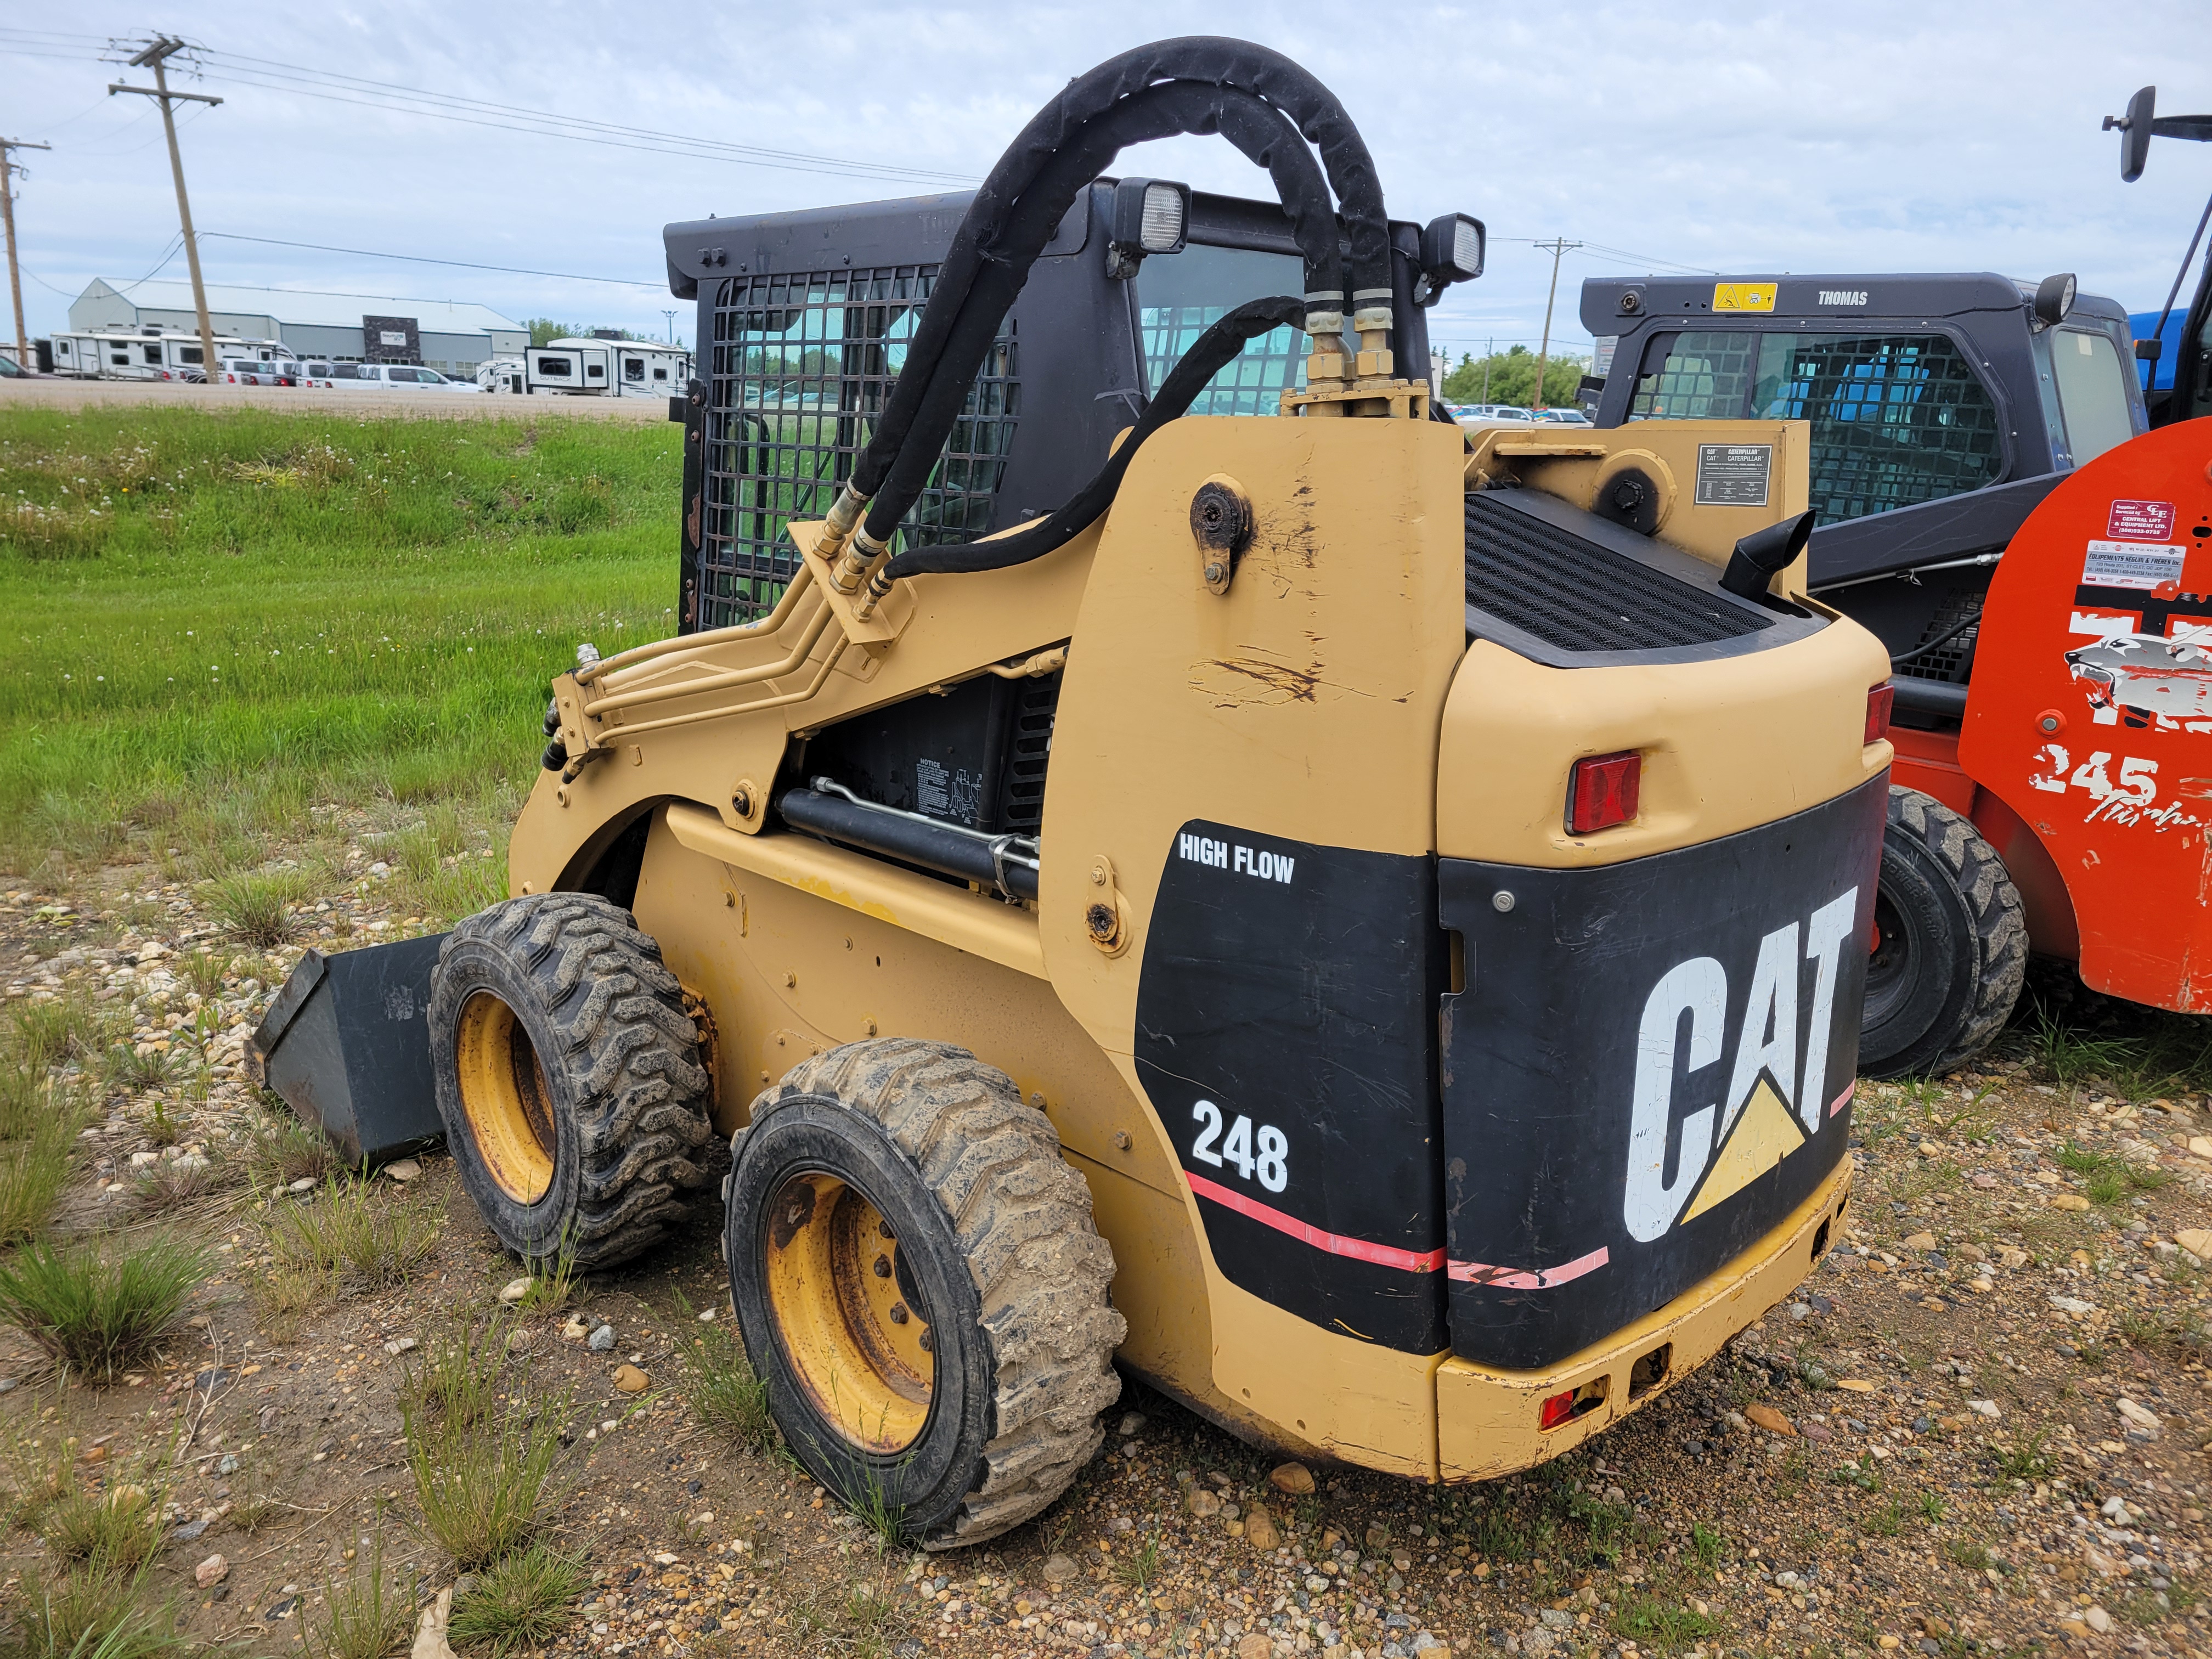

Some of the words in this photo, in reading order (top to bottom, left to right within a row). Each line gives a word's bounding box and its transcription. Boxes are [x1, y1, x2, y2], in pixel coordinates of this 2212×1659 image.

[1819, 291, 1868, 306] THOMAS
[2089, 552, 2124, 561] ÉQUIPEMENTS
[920, 758, 941, 769] NOTICE
[2028, 744, 2159, 807] 245
[1180, 832, 1228, 869] HIGH
[1234, 845, 1295, 884] FLOW
[1881, 856, 1921, 899] POWER
[1920, 904, 1940, 940] GRIP
[1624, 885, 1858, 1243] CAT
[1193, 1100, 1289, 1193] 248
